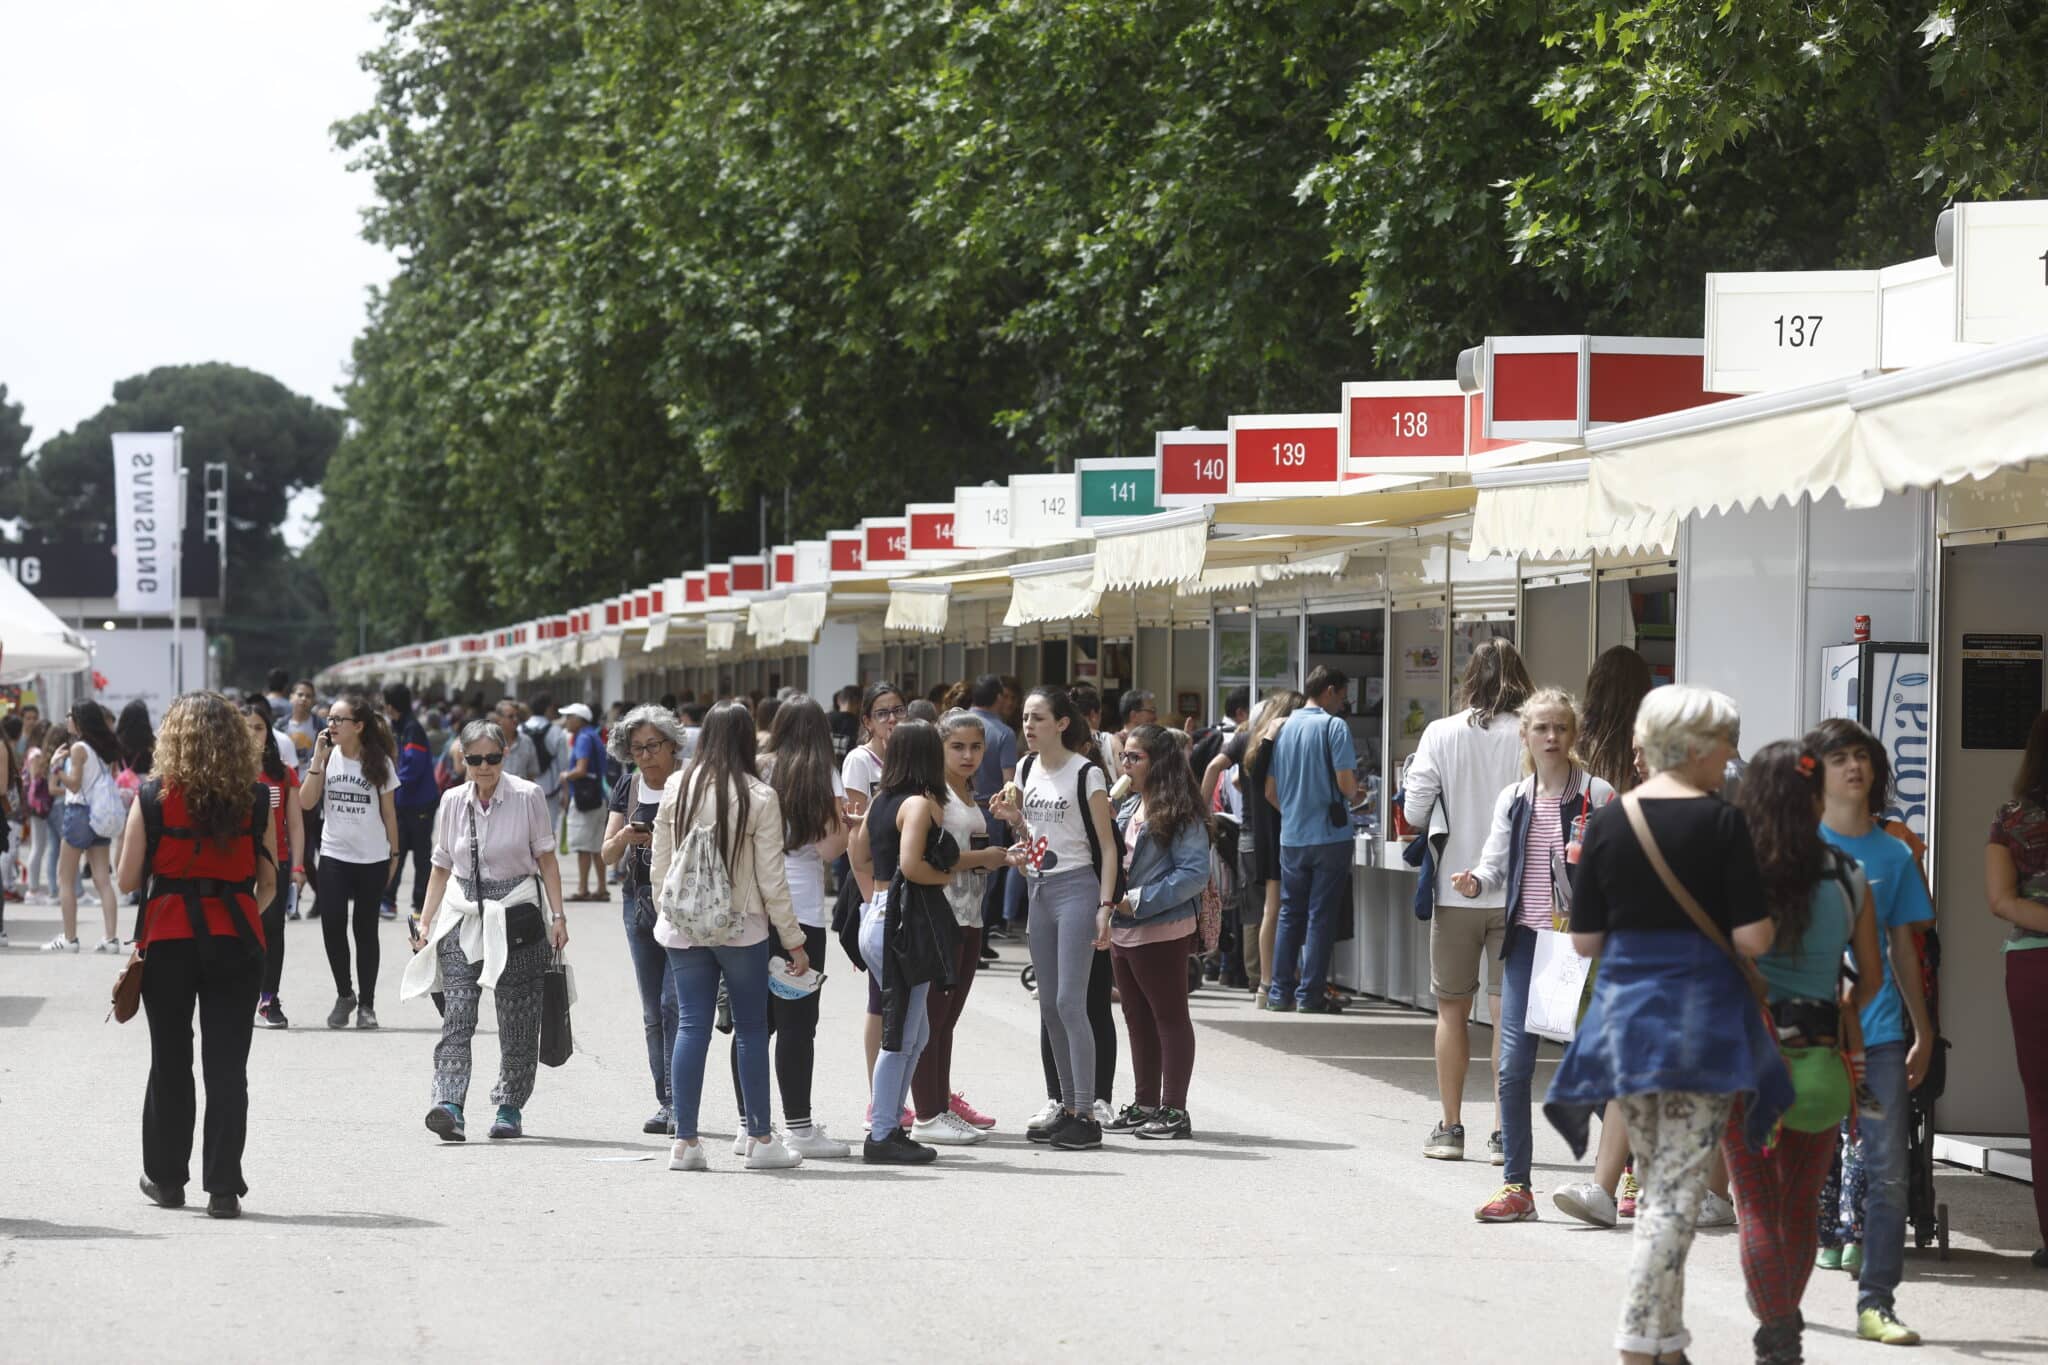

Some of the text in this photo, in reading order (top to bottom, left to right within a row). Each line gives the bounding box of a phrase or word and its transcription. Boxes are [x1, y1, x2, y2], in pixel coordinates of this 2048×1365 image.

[1774, 315, 1823, 347] 137
[1391, 411, 1429, 438] 138
[1272, 442, 1306, 466] 139
[1193, 459, 1224, 481] 140
[1110, 482, 1137, 502] 141
[985, 508, 1008, 525] 143
[1041, 497, 1066, 516] 142
[337, 805, 366, 814] ALWAYS
